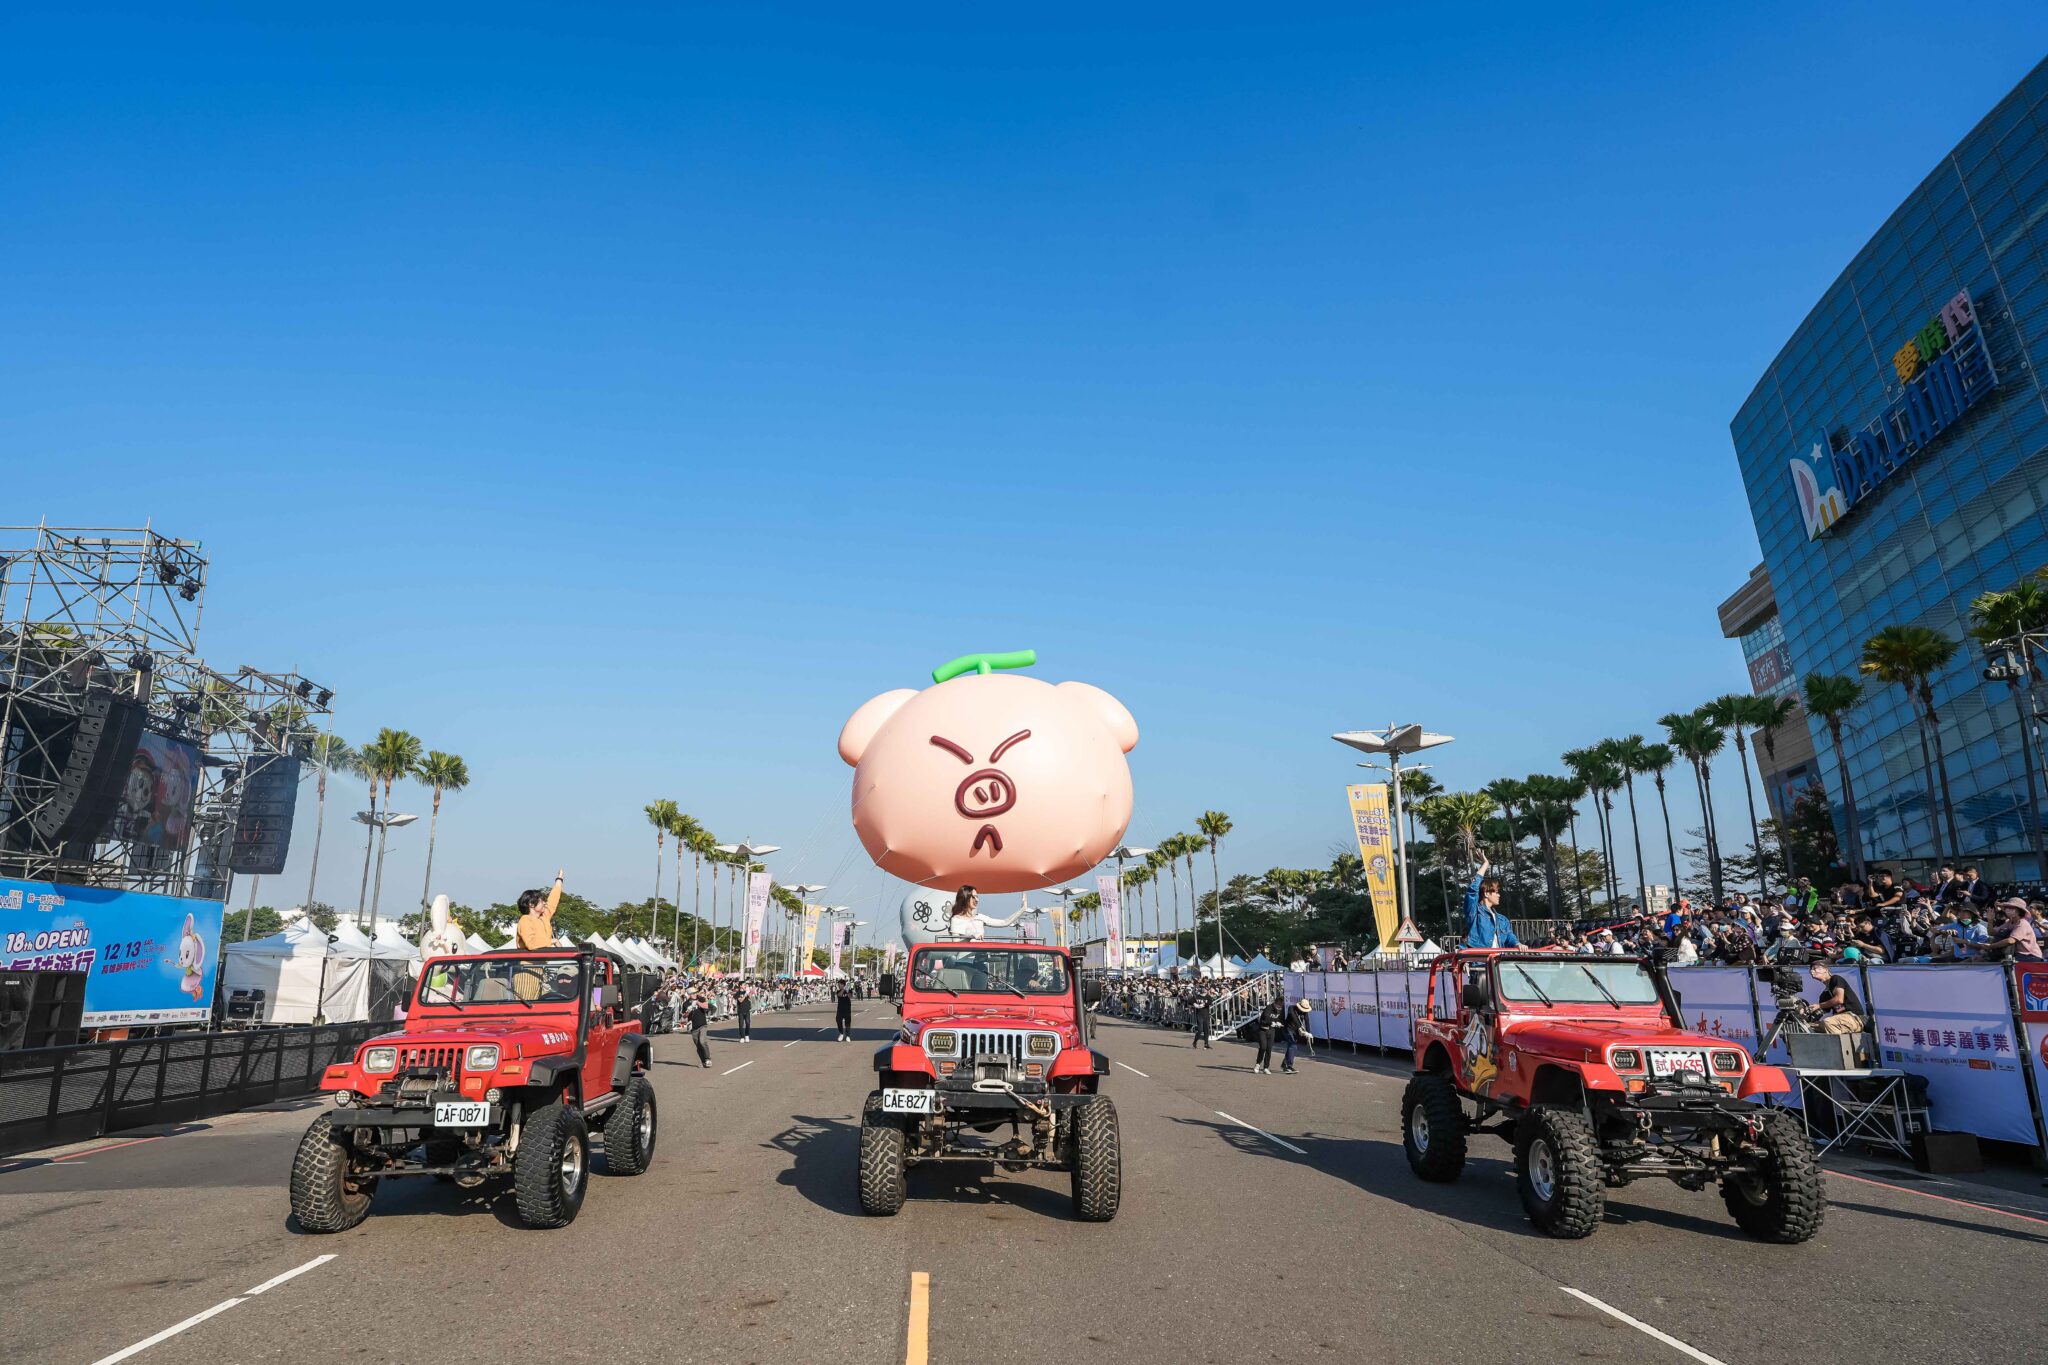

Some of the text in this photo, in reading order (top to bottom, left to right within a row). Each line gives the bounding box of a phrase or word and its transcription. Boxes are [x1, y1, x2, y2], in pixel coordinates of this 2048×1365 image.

[1893, 290, 1975, 385] 夢時代
[1836, 352, 1968, 507] DREAM
[6, 928, 90, 953] 18th OPEN!
[104, 941, 142, 960] 12/13
[1884, 1027, 2010, 1053] 統一集團美麗事業
